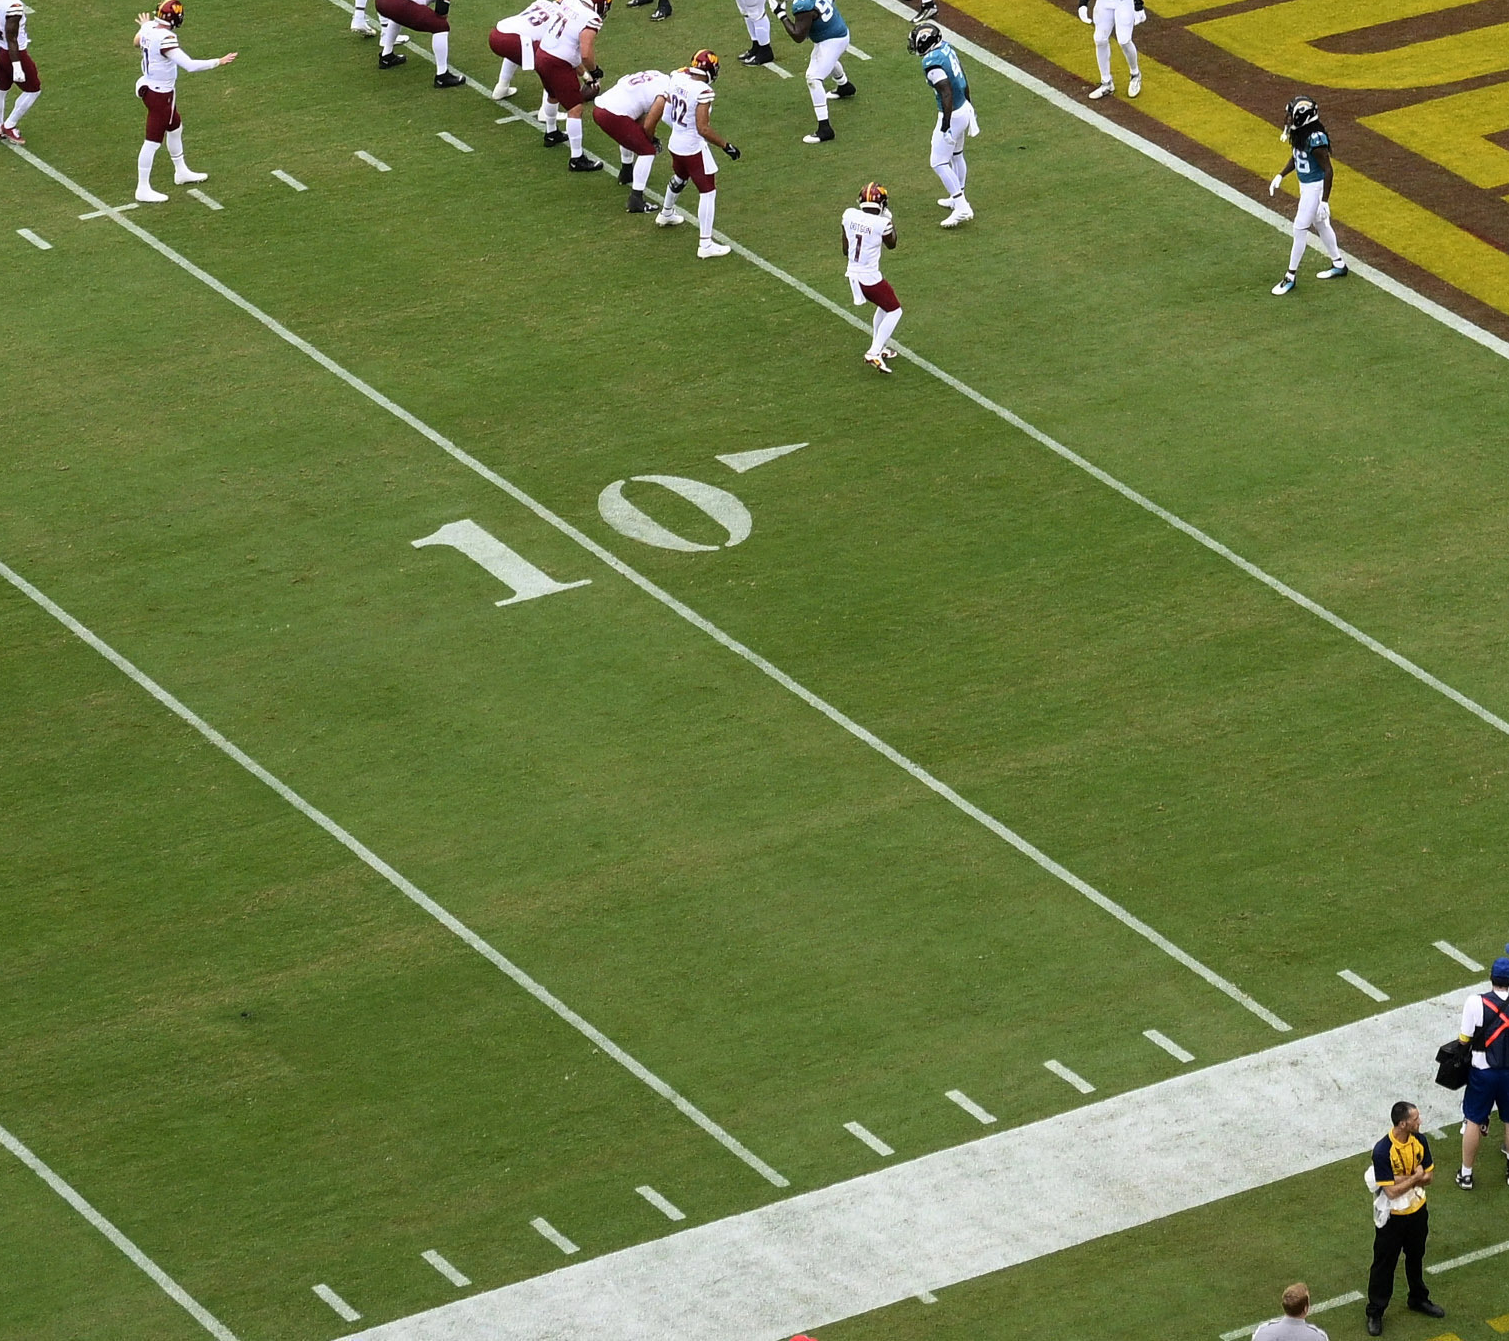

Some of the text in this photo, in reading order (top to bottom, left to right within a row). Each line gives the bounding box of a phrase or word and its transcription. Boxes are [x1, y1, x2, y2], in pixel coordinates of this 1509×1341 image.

[671, 95, 688, 127] 82
[853, 234, 864, 263] 1
[411, 472, 755, 608] 10
